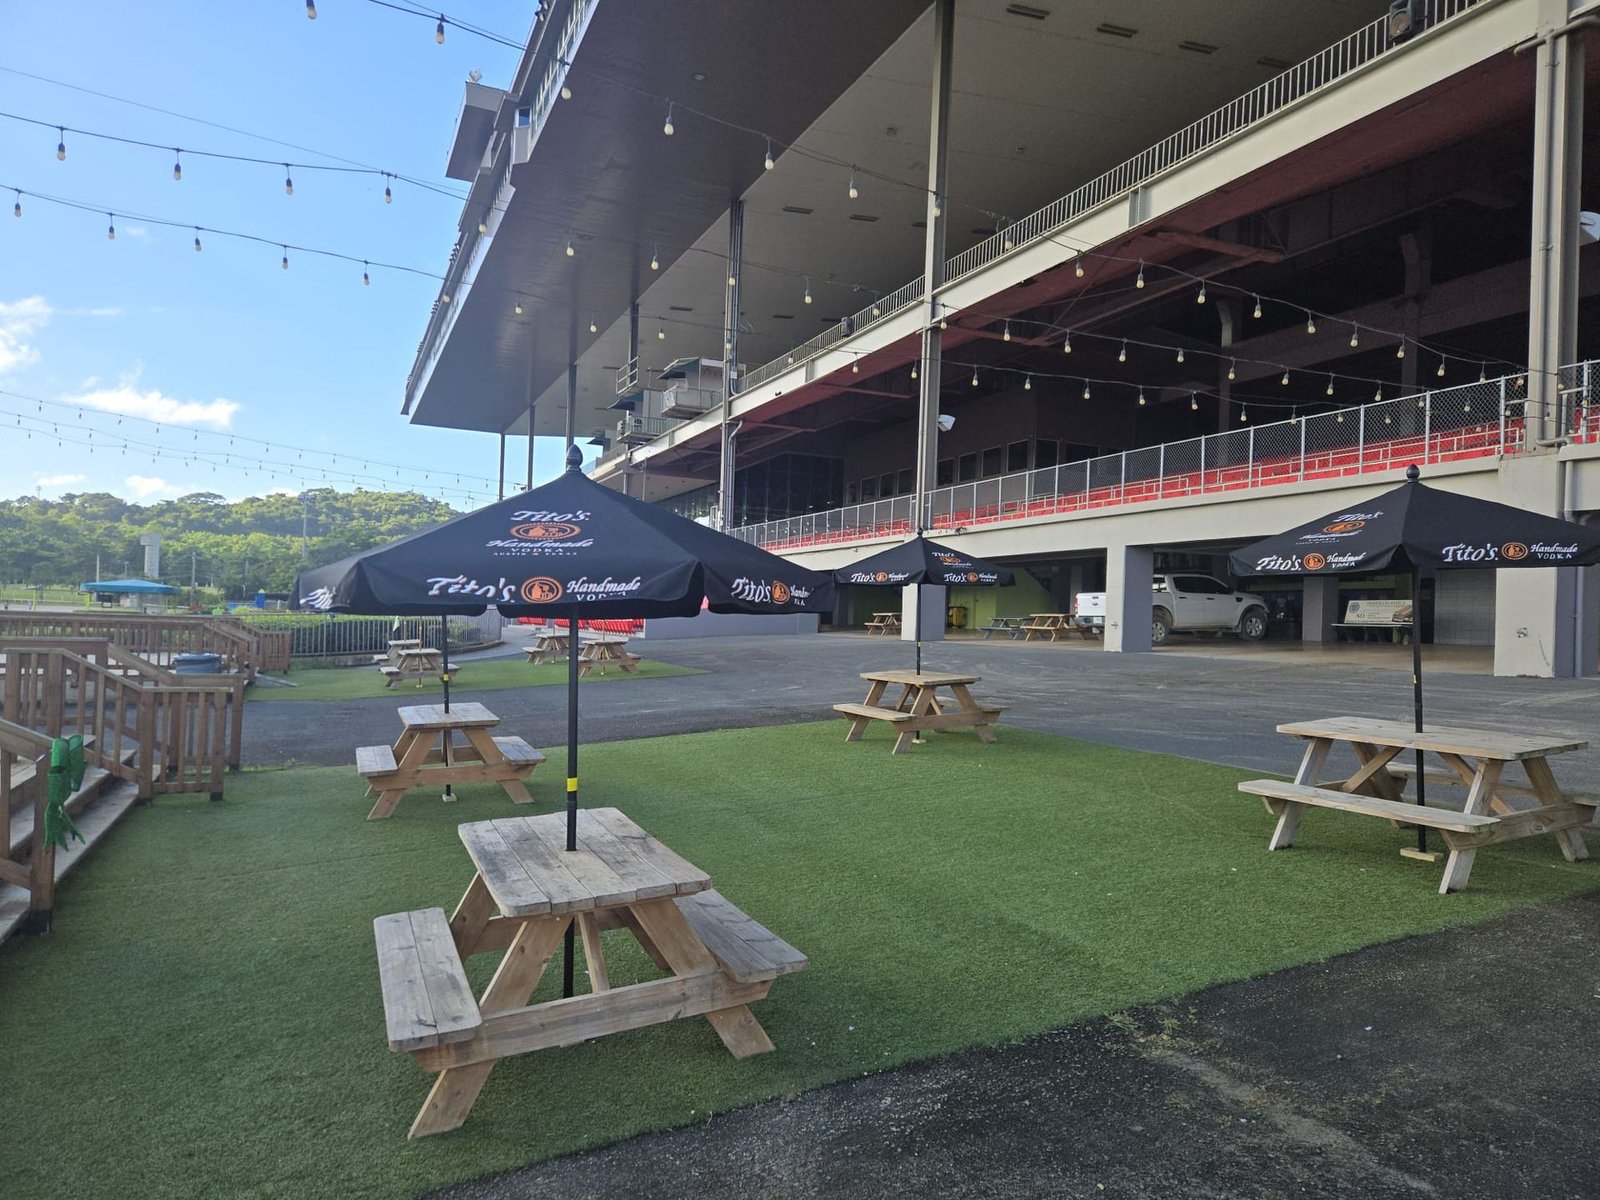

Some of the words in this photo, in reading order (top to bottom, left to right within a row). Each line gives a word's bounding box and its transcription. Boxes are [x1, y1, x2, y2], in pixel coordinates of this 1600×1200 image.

[510, 510, 591, 522] Tito's
[485, 538, 594, 548] Handmade
[1442, 543, 1499, 562] Tito's
[1530, 542, 1578, 553] Handmade
[1256, 555, 1302, 571] Tito's
[850, 572, 876, 583] Tito's
[944, 573, 967, 583] Tito's
[426, 574, 516, 603] Tito's
[566, 575, 642, 593] Handmade
[730, 577, 773, 603] Tito's
